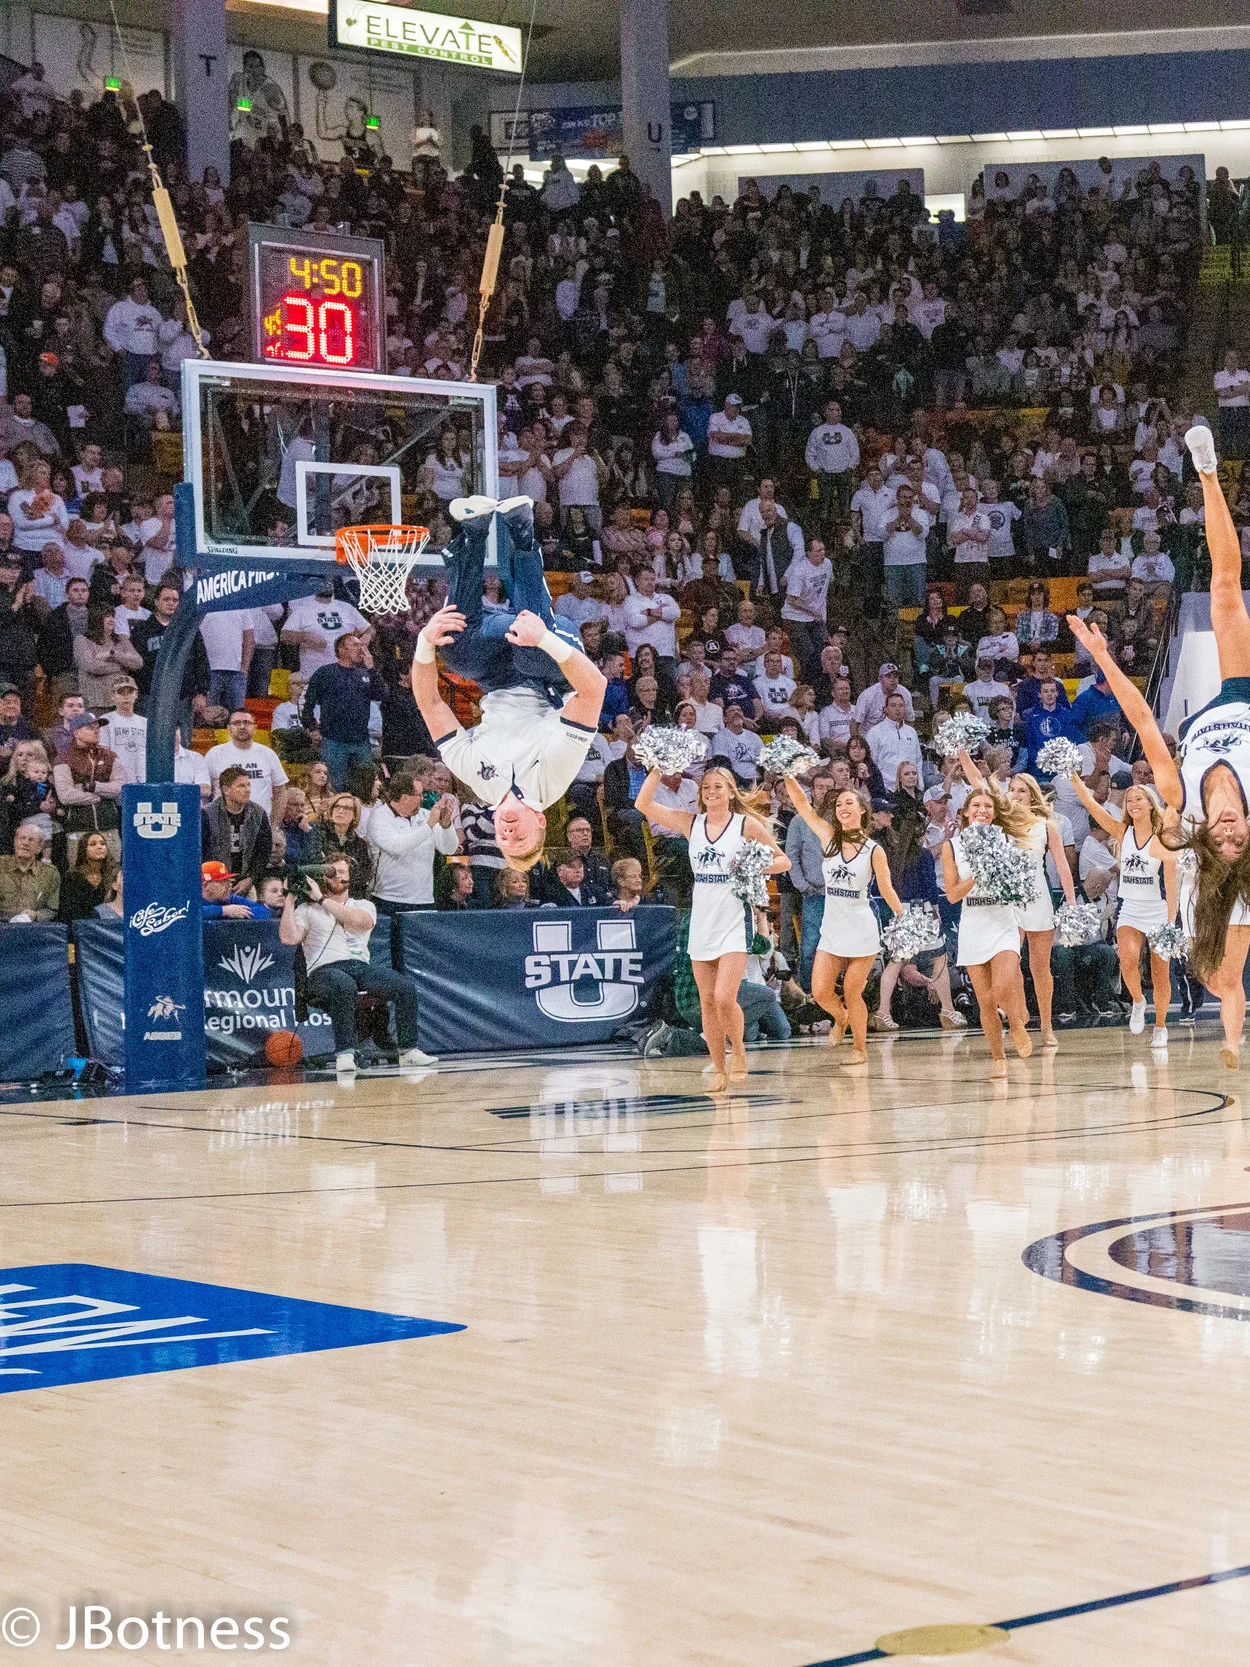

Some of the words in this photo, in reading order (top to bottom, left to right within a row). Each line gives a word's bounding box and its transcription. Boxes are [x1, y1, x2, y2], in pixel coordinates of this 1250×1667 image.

[367, 15, 492, 54] ELEVATE
[369, 38, 410, 54] PEST
[417, 46, 489, 64] CONTROL
[200, 55, 216, 76] T
[647, 121, 662, 143] U
[289, 257, 362, 297] 4:50
[284, 296, 353, 364] 30
[206, 546, 238, 555] SPALDING
[197, 570, 247, 604] AMERICA
[317, 618, 344, 626] STATE
[133, 813, 182, 828] STATE
[1136, 876, 1154, 884] STATE
[840, 889, 860, 899] STATE
[967, 897, 986, 906] UTAH
[525, 952, 645, 989] STATE
